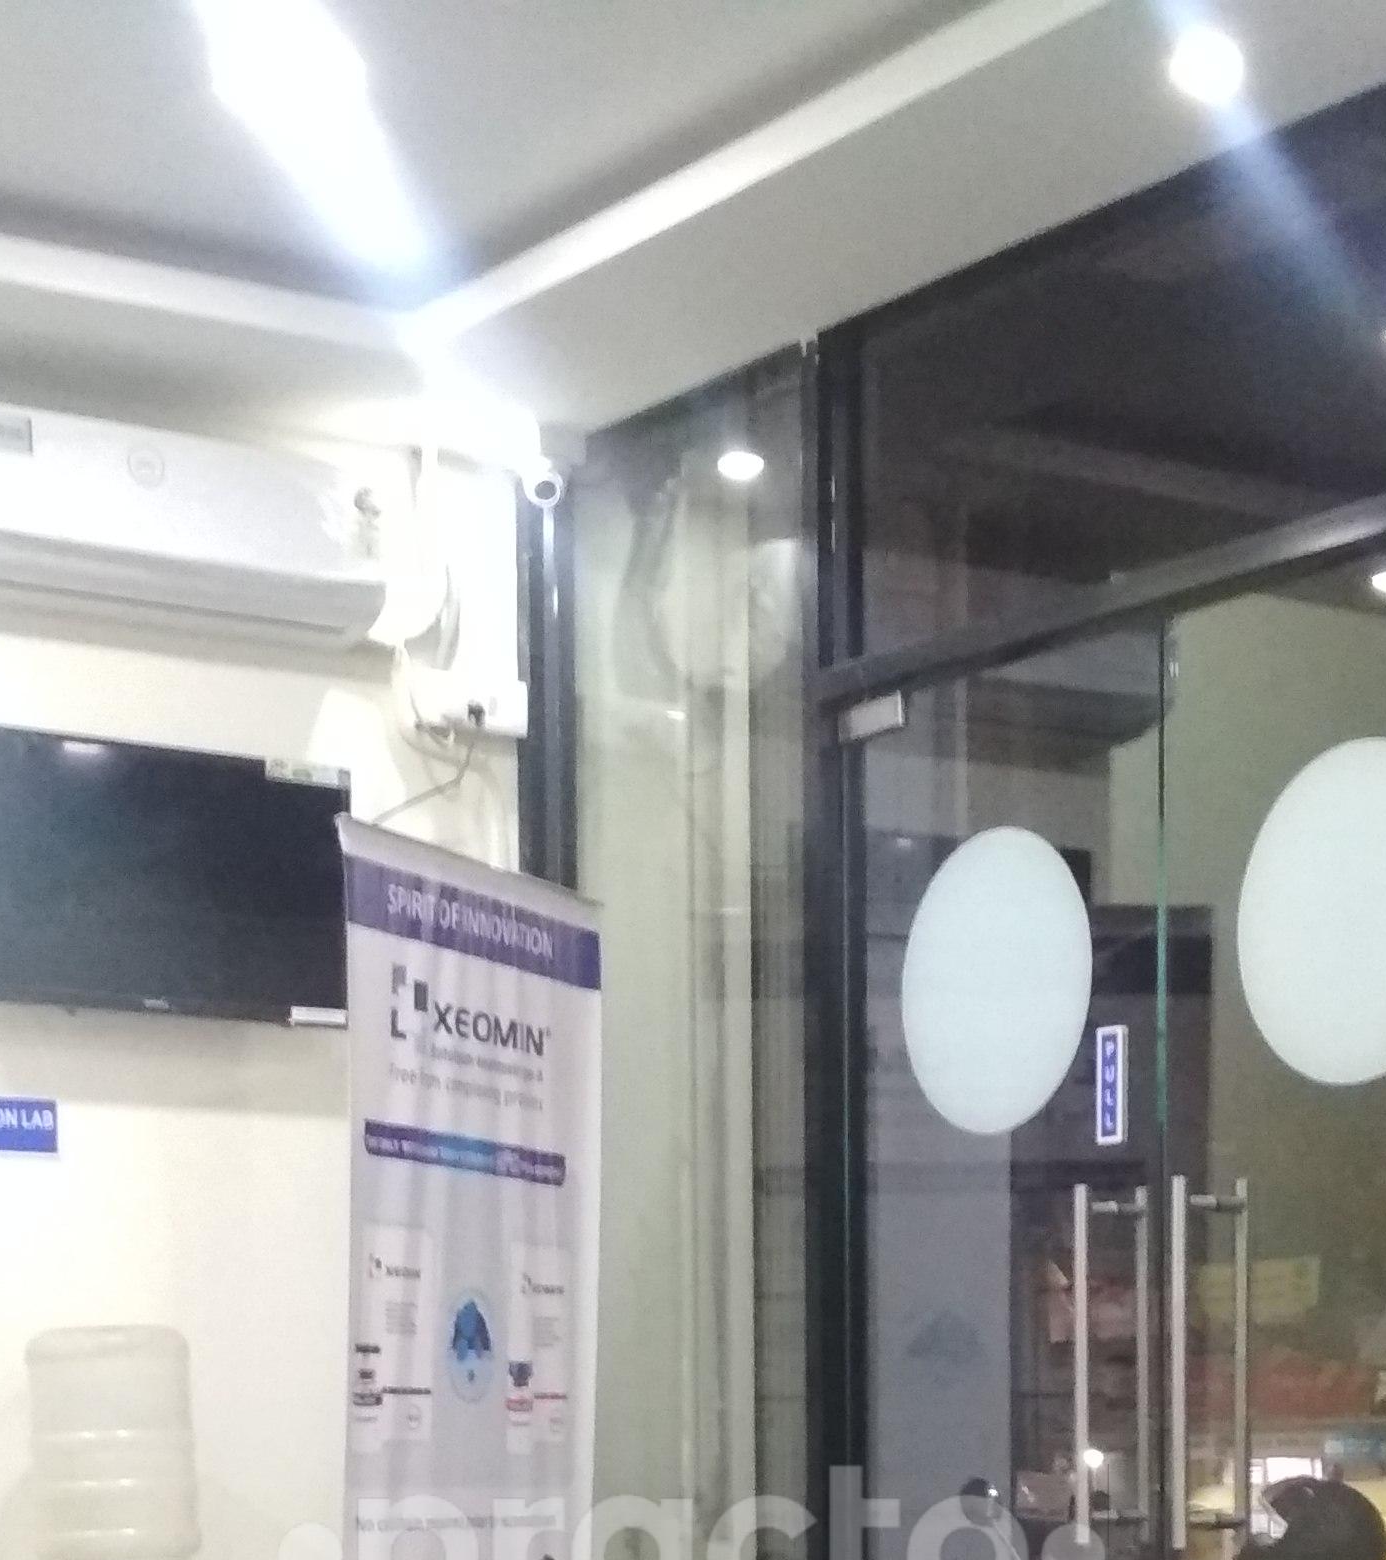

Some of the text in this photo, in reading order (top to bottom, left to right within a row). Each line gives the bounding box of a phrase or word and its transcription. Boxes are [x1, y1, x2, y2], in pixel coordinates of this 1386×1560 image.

[387, 883, 554, 960] SPIRIT OF INNOVATION
[21, 1108, 54, 1130] LAB
[1104, 1040, 1115, 1130] PULL
